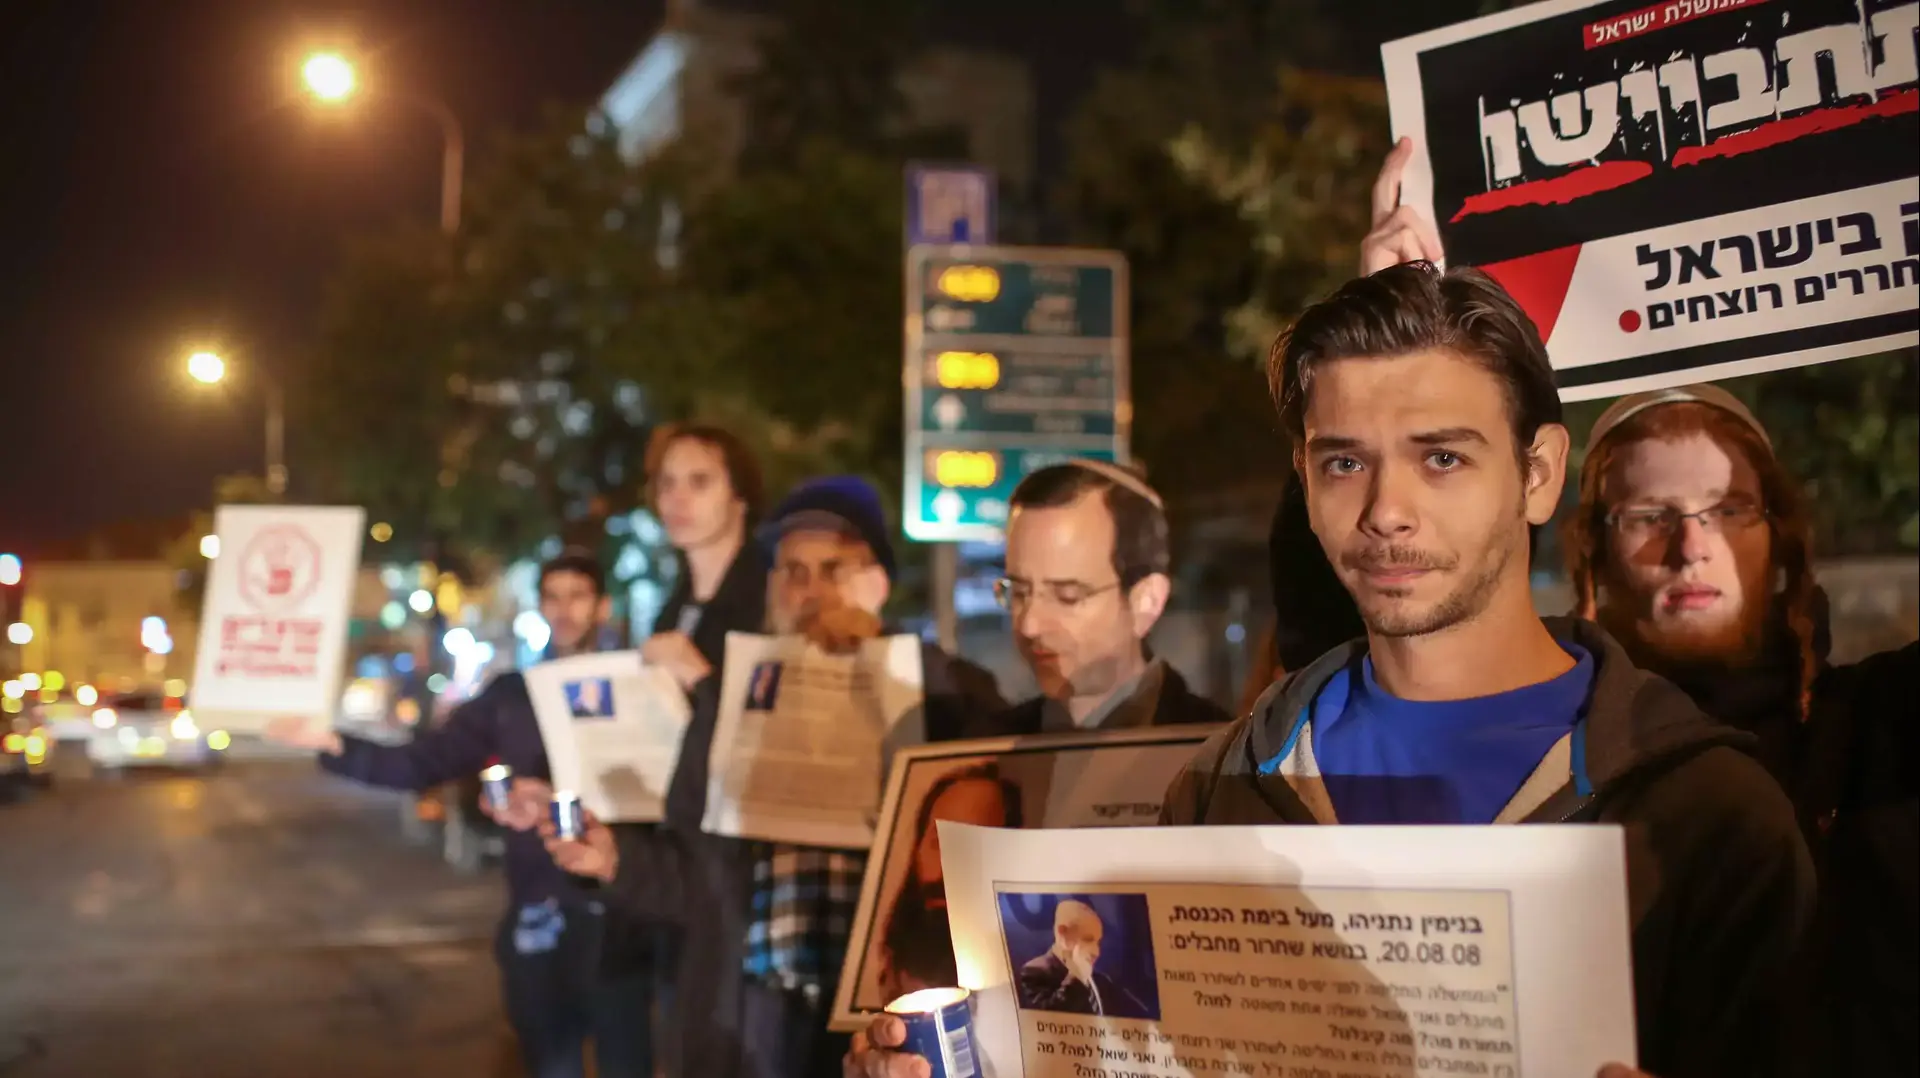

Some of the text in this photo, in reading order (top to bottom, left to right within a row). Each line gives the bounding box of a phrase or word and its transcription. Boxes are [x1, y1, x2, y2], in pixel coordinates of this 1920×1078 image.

[1591, 16, 1656, 43] ישראל
[1636, 211, 1882, 291] בישראל
[1647, 282, 1783, 330] רוצחים
[1168, 904, 1483, 936] בנימין נתניהו, מעל בימת הכנסת,
[1246, 937, 1305, 957] שחרור
[1312, 941, 1368, 961] בנושא
[1193, 989, 1232, 1008] למה?
[1036, 1021, 1085, 1037] הרוצחים
[1089, 1026, 1106, 1038] את
[1122, 1027, 1173, 1043] ישראלים
[1389, 1031, 1414, 1047] מה
[1036, 1041, 1055, 1054] מה
[1060, 1042, 1093, 1058] למה?
[1096, 1047, 1128, 1063] שואל
[1132, 1052, 1156, 1064] ואני
